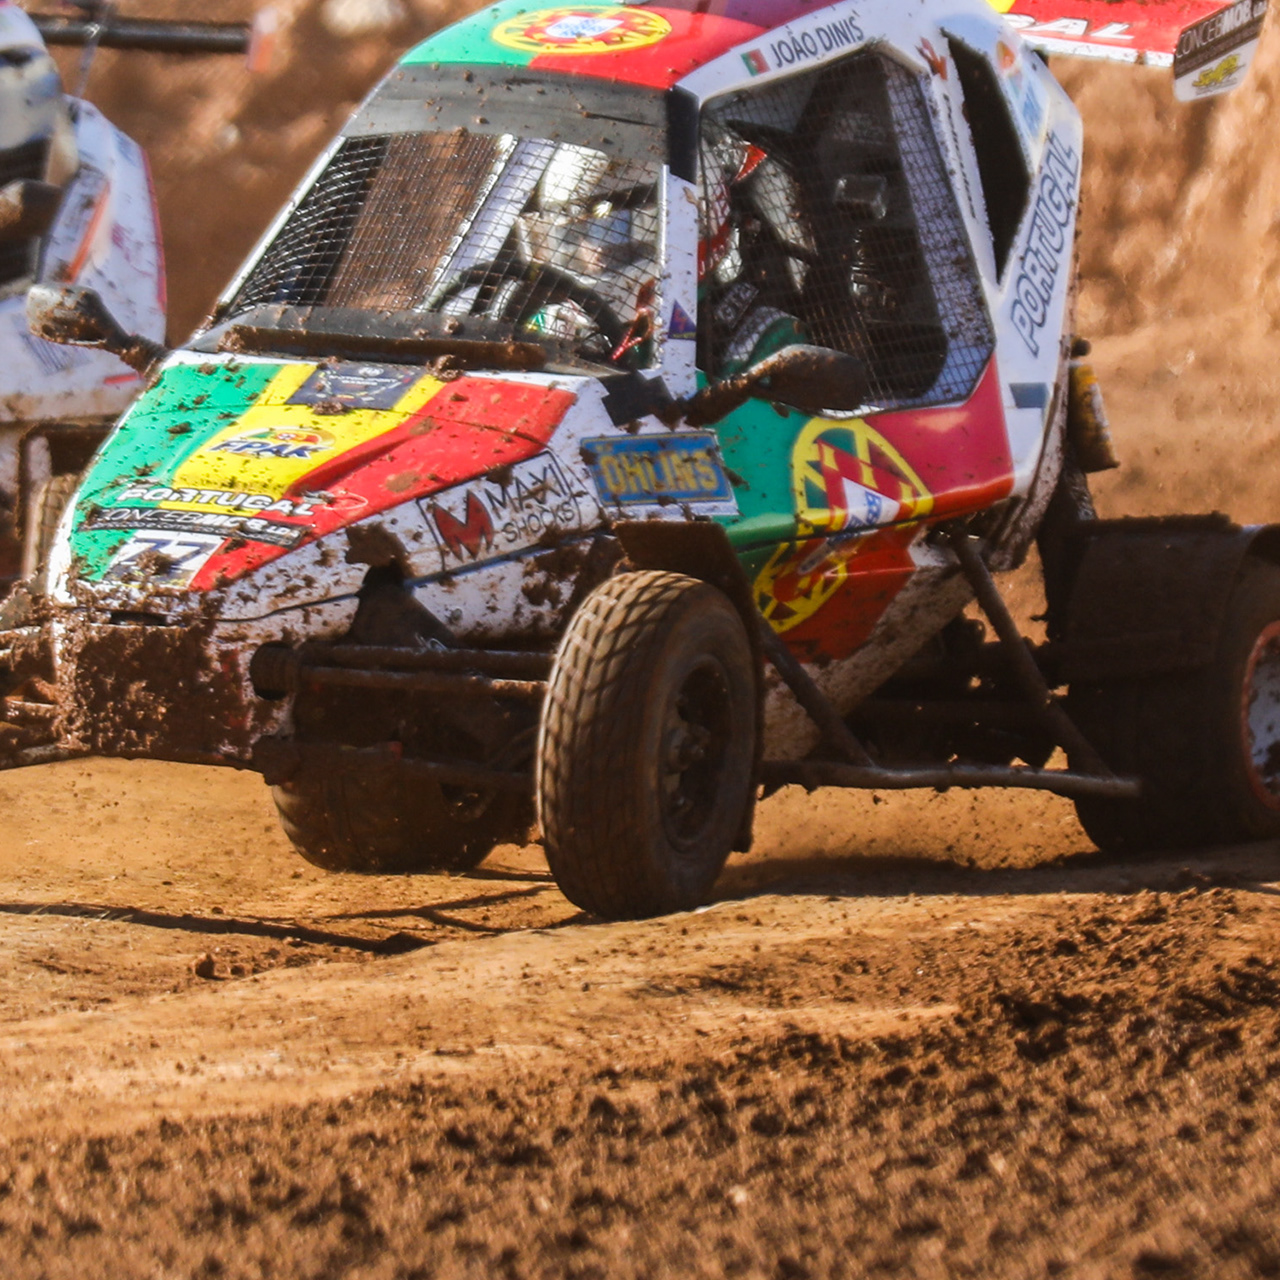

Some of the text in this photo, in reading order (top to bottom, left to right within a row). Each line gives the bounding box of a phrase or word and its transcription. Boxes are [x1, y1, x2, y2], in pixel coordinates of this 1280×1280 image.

[815, 16, 864, 51] DINIS
[1012, 130, 1079, 358] PORTUGAL
[208, 440, 330, 459] FPAK
[116, 486, 314, 516] PORTUGAL
[485, 465, 568, 520] MAXI
[503, 501, 576, 543] SHOCKS
